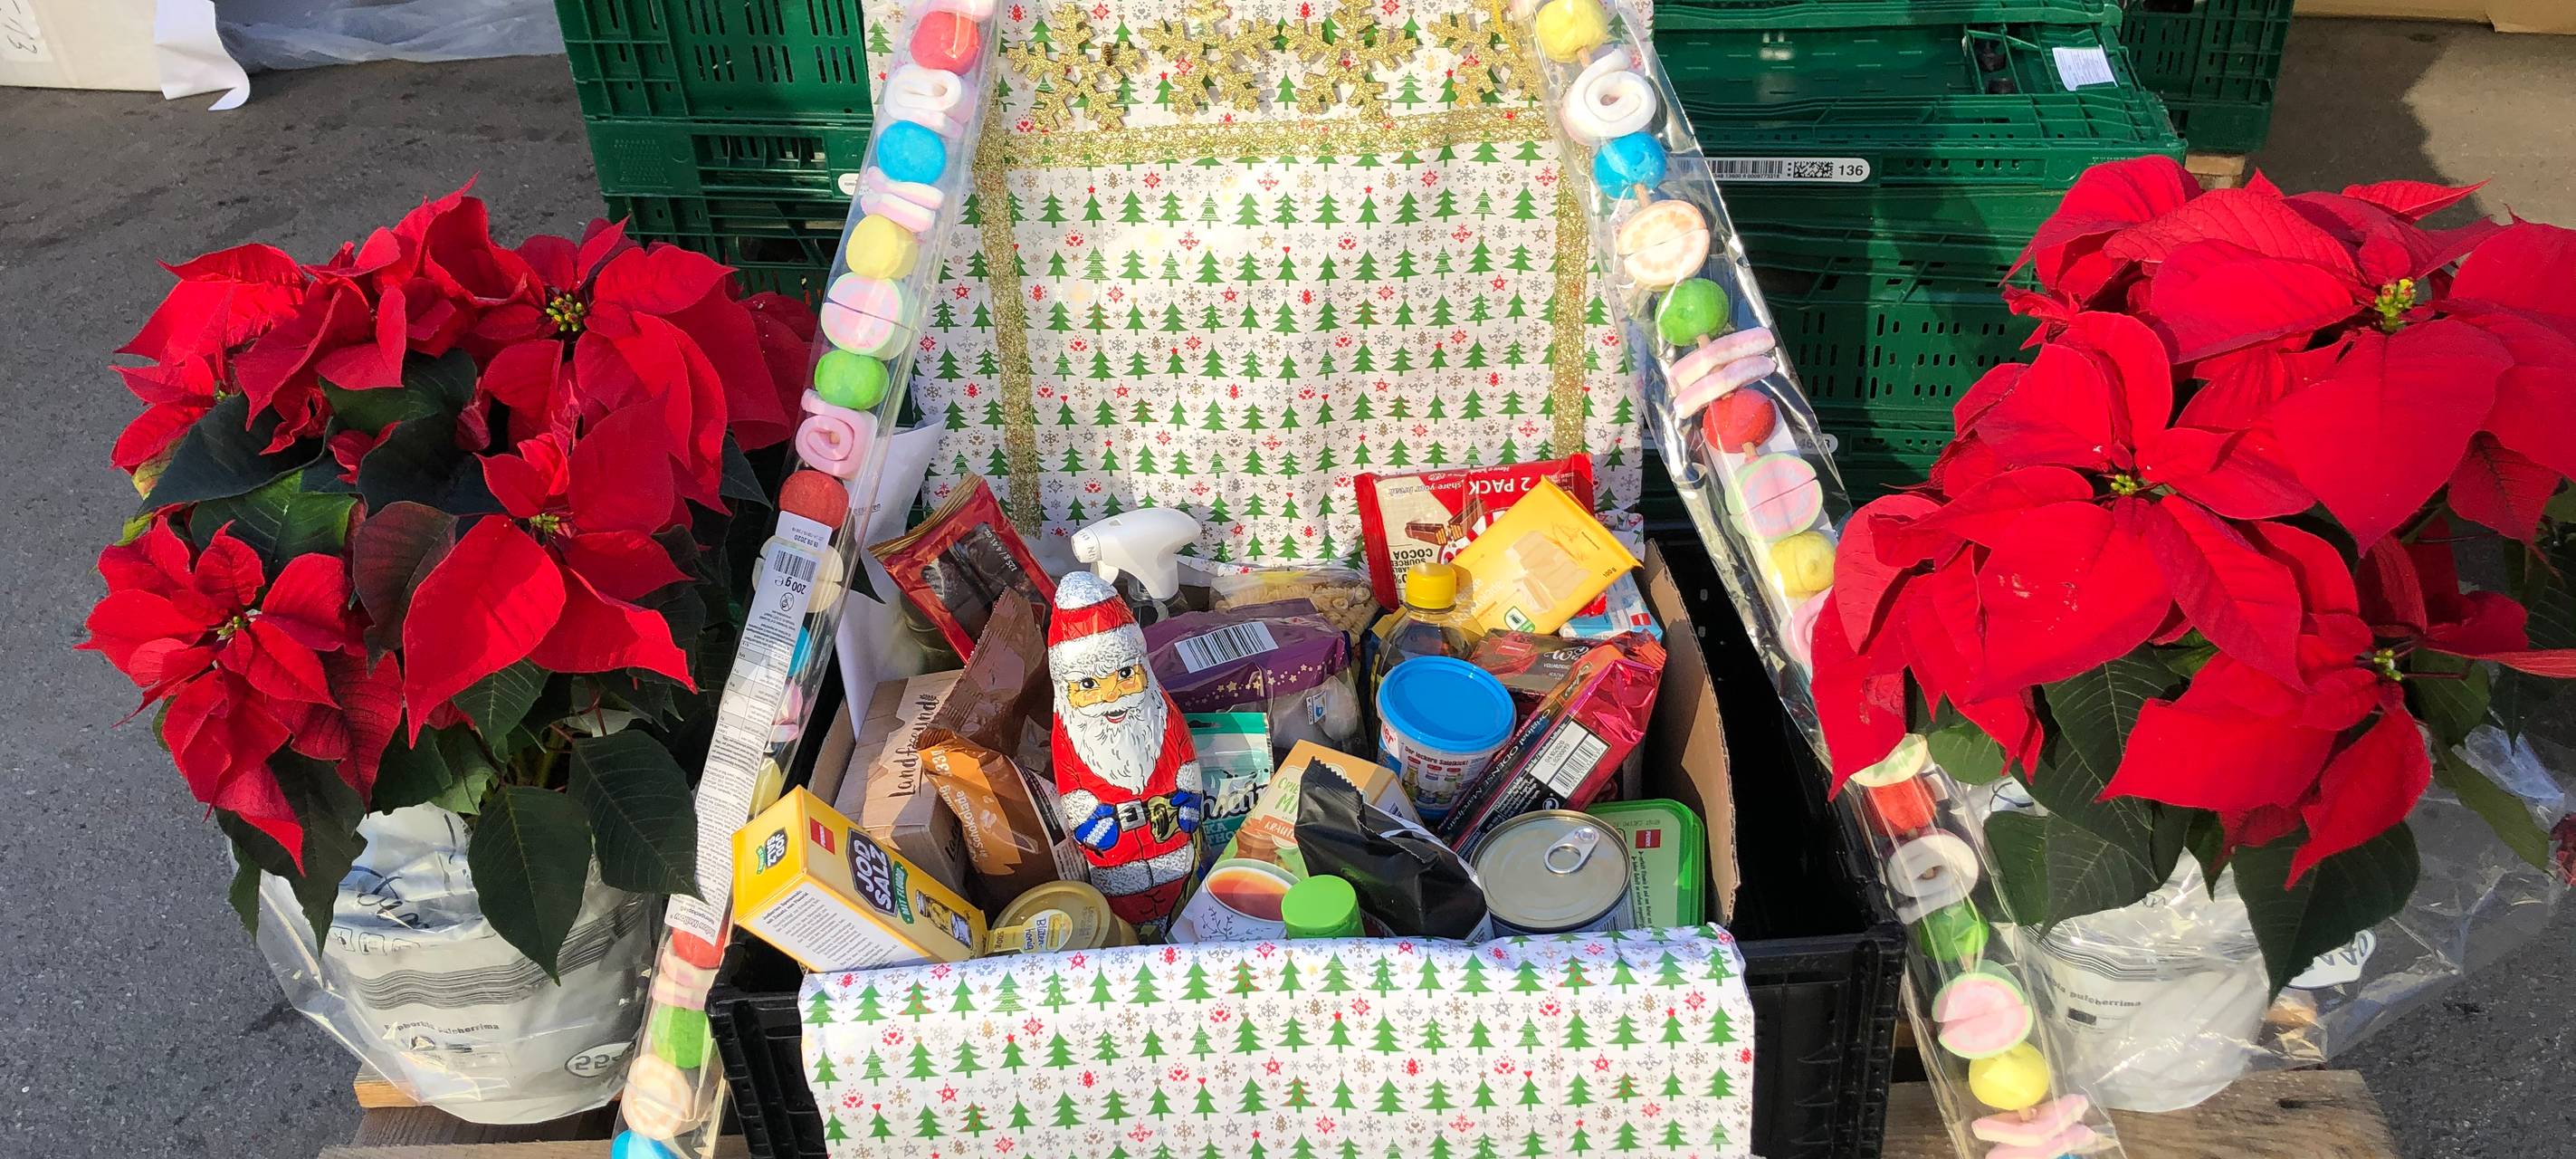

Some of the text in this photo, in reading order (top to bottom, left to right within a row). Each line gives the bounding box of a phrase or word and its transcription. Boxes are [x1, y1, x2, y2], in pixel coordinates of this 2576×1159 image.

[1838, 165, 1864, 176] 136
[1437, 482, 1462, 491] share
[1468, 480, 1514, 495] PACK
[1521, 476, 1531, 491] 2
[1392, 548, 1433, 560] COCOA
[1005, 560, 1017, 571] 125
[785, 577, 806, 595] 200 g
[1520, 709, 1550, 746] Original
[1485, 745, 1520, 785] ODENSE
[766, 835, 777, 867] SALZ
[776, 833, 785, 857] JOD
[854, 839, 874, 893] JOD
[869, 844, 892, 910] SALZ
[899, 897, 911, 916] MIT
